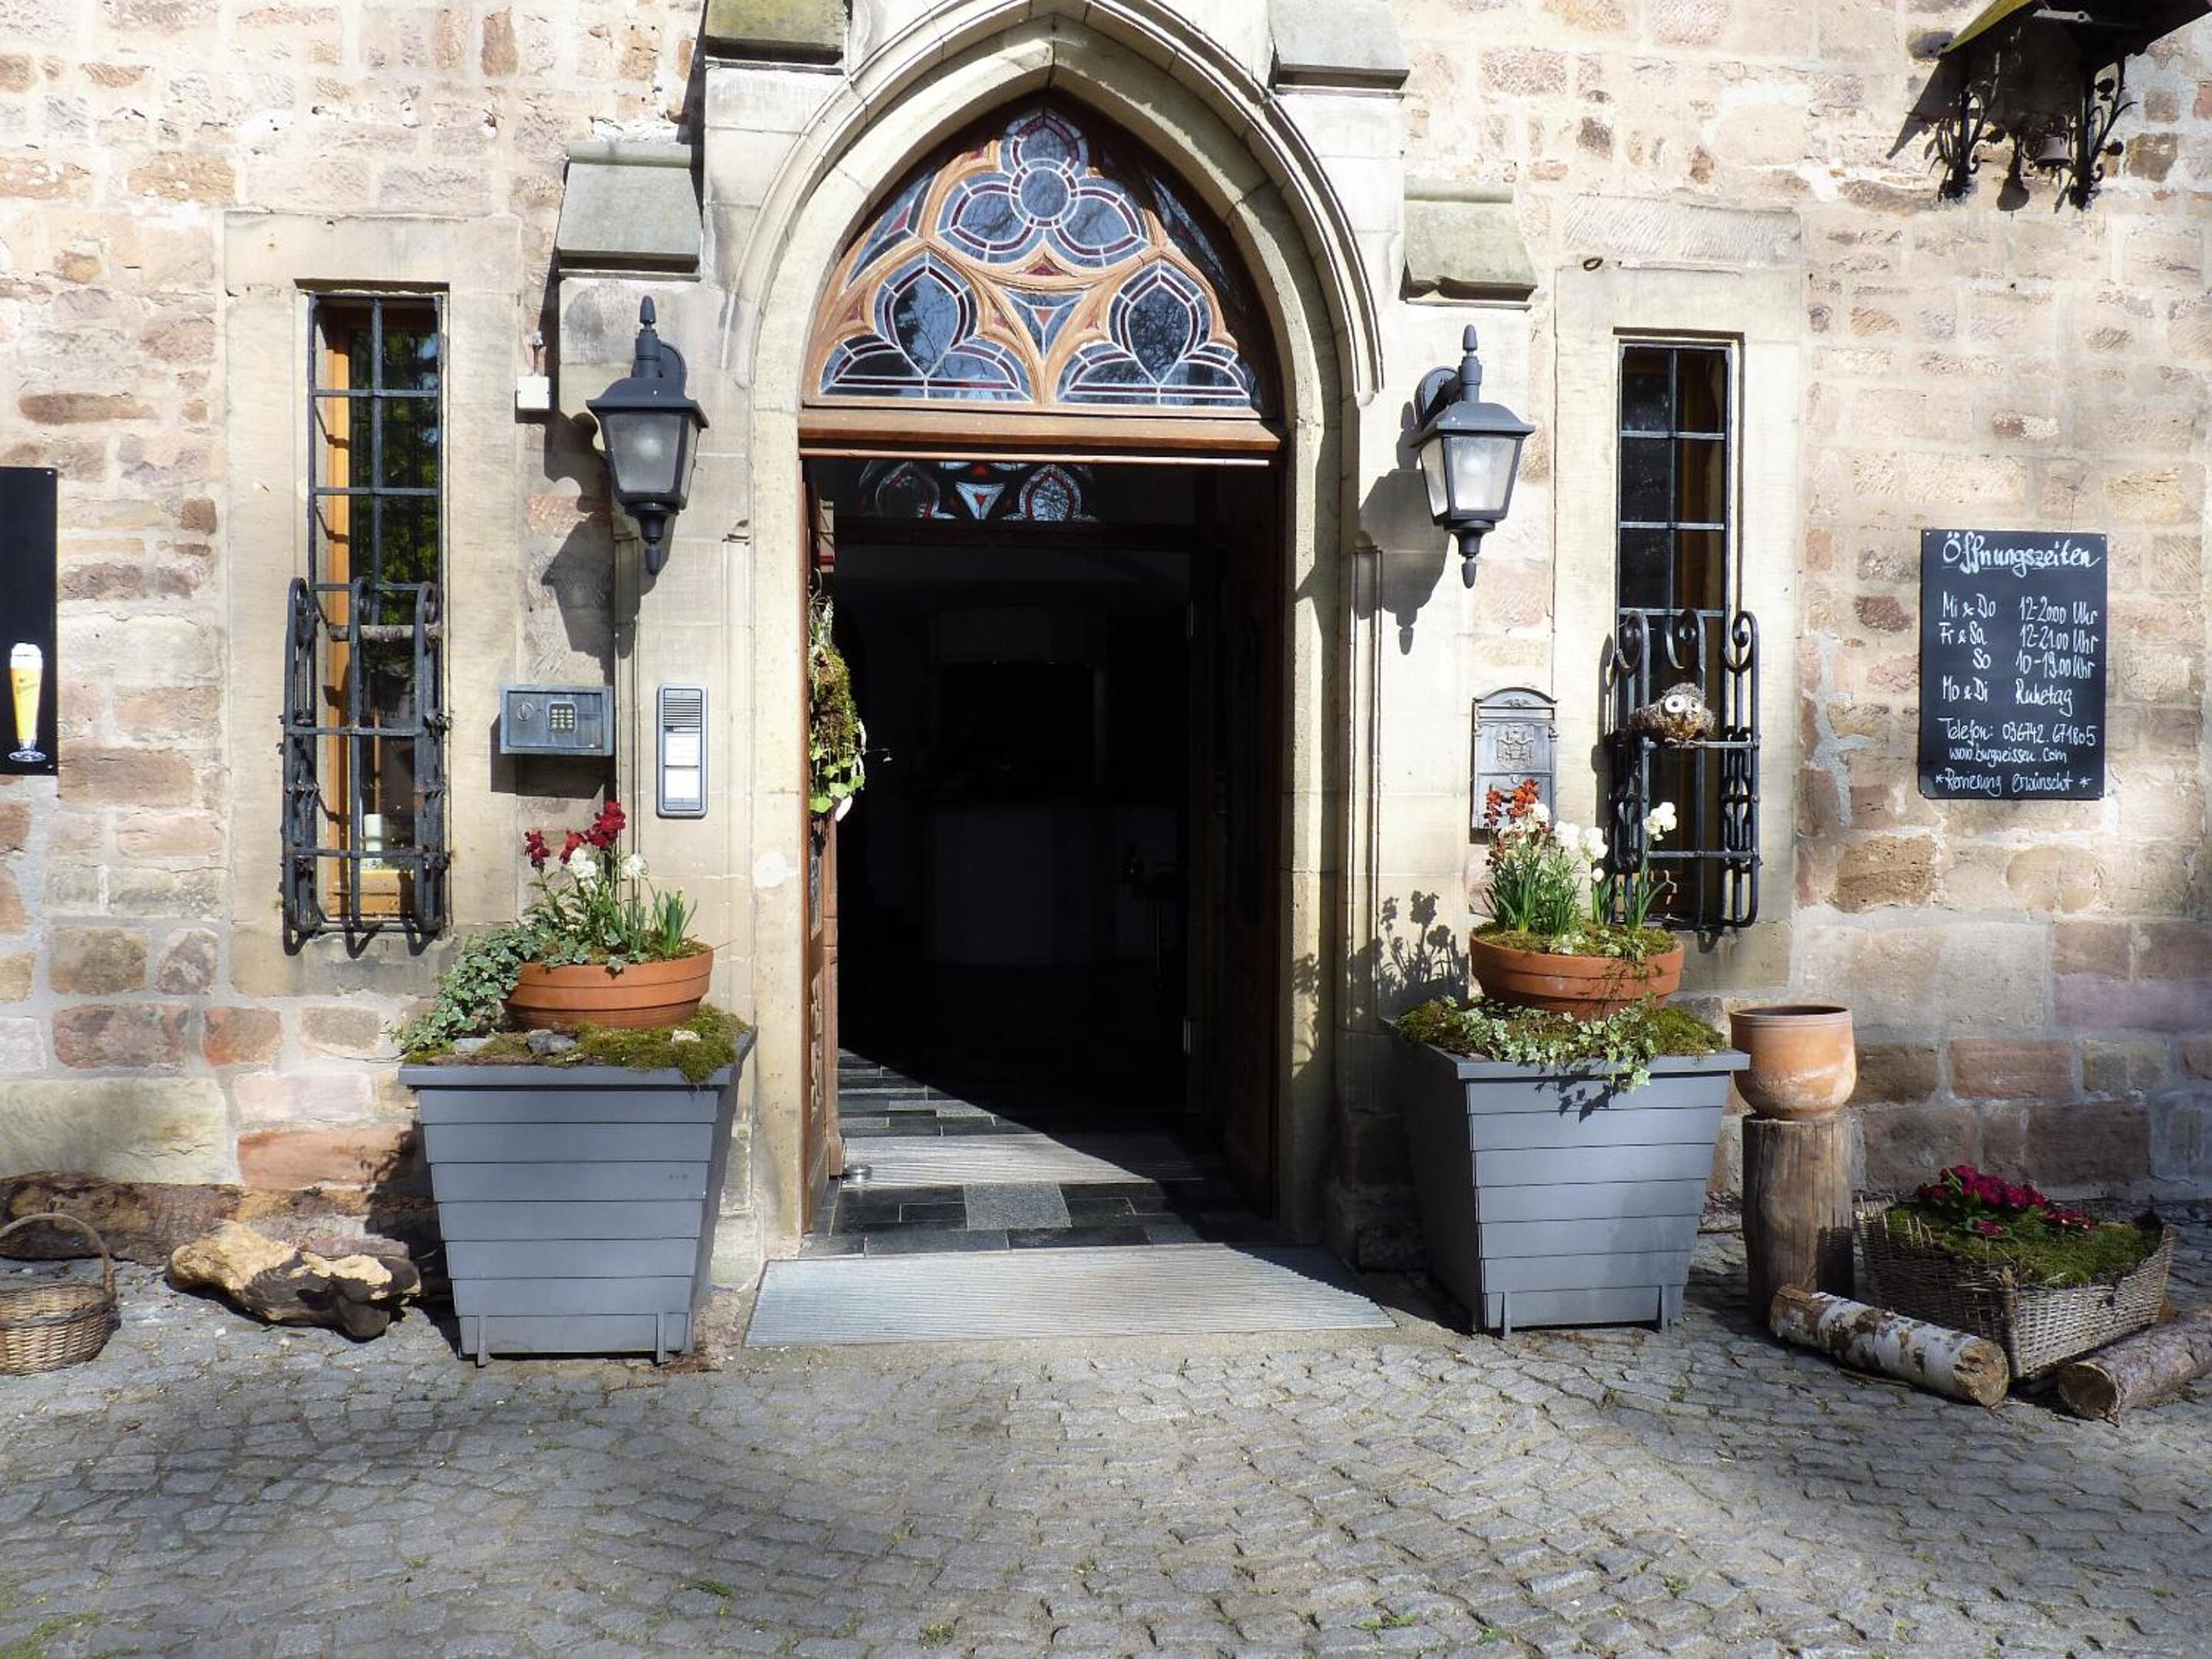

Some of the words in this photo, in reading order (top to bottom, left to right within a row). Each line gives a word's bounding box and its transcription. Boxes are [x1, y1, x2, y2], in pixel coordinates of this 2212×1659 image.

[1943, 531, 2101, 577] Öffnungszeiten
[1943, 591, 1958, 618] Mi
[1962, 602, 1975, 618] &
[1976, 593, 1996, 619] Do
[2072, 601, 2098, 626] Uhr
[1939, 622, 1955, 645] Fr
[1958, 630, 1967, 645] &
[1969, 620, 1989, 645] Sa
[2073, 628, 2099, 654] Uhr
[1972, 648, 1992, 669] So
[2072, 655, 2095, 679] Uhr
[1943, 675, 1960, 702] Mo
[1964, 685, 1972, 700] &
[1972, 676, 1989, 702] Di
[2015, 678, 2072, 717] Ruhetag
[1937, 718, 1994, 747] Telefon:
